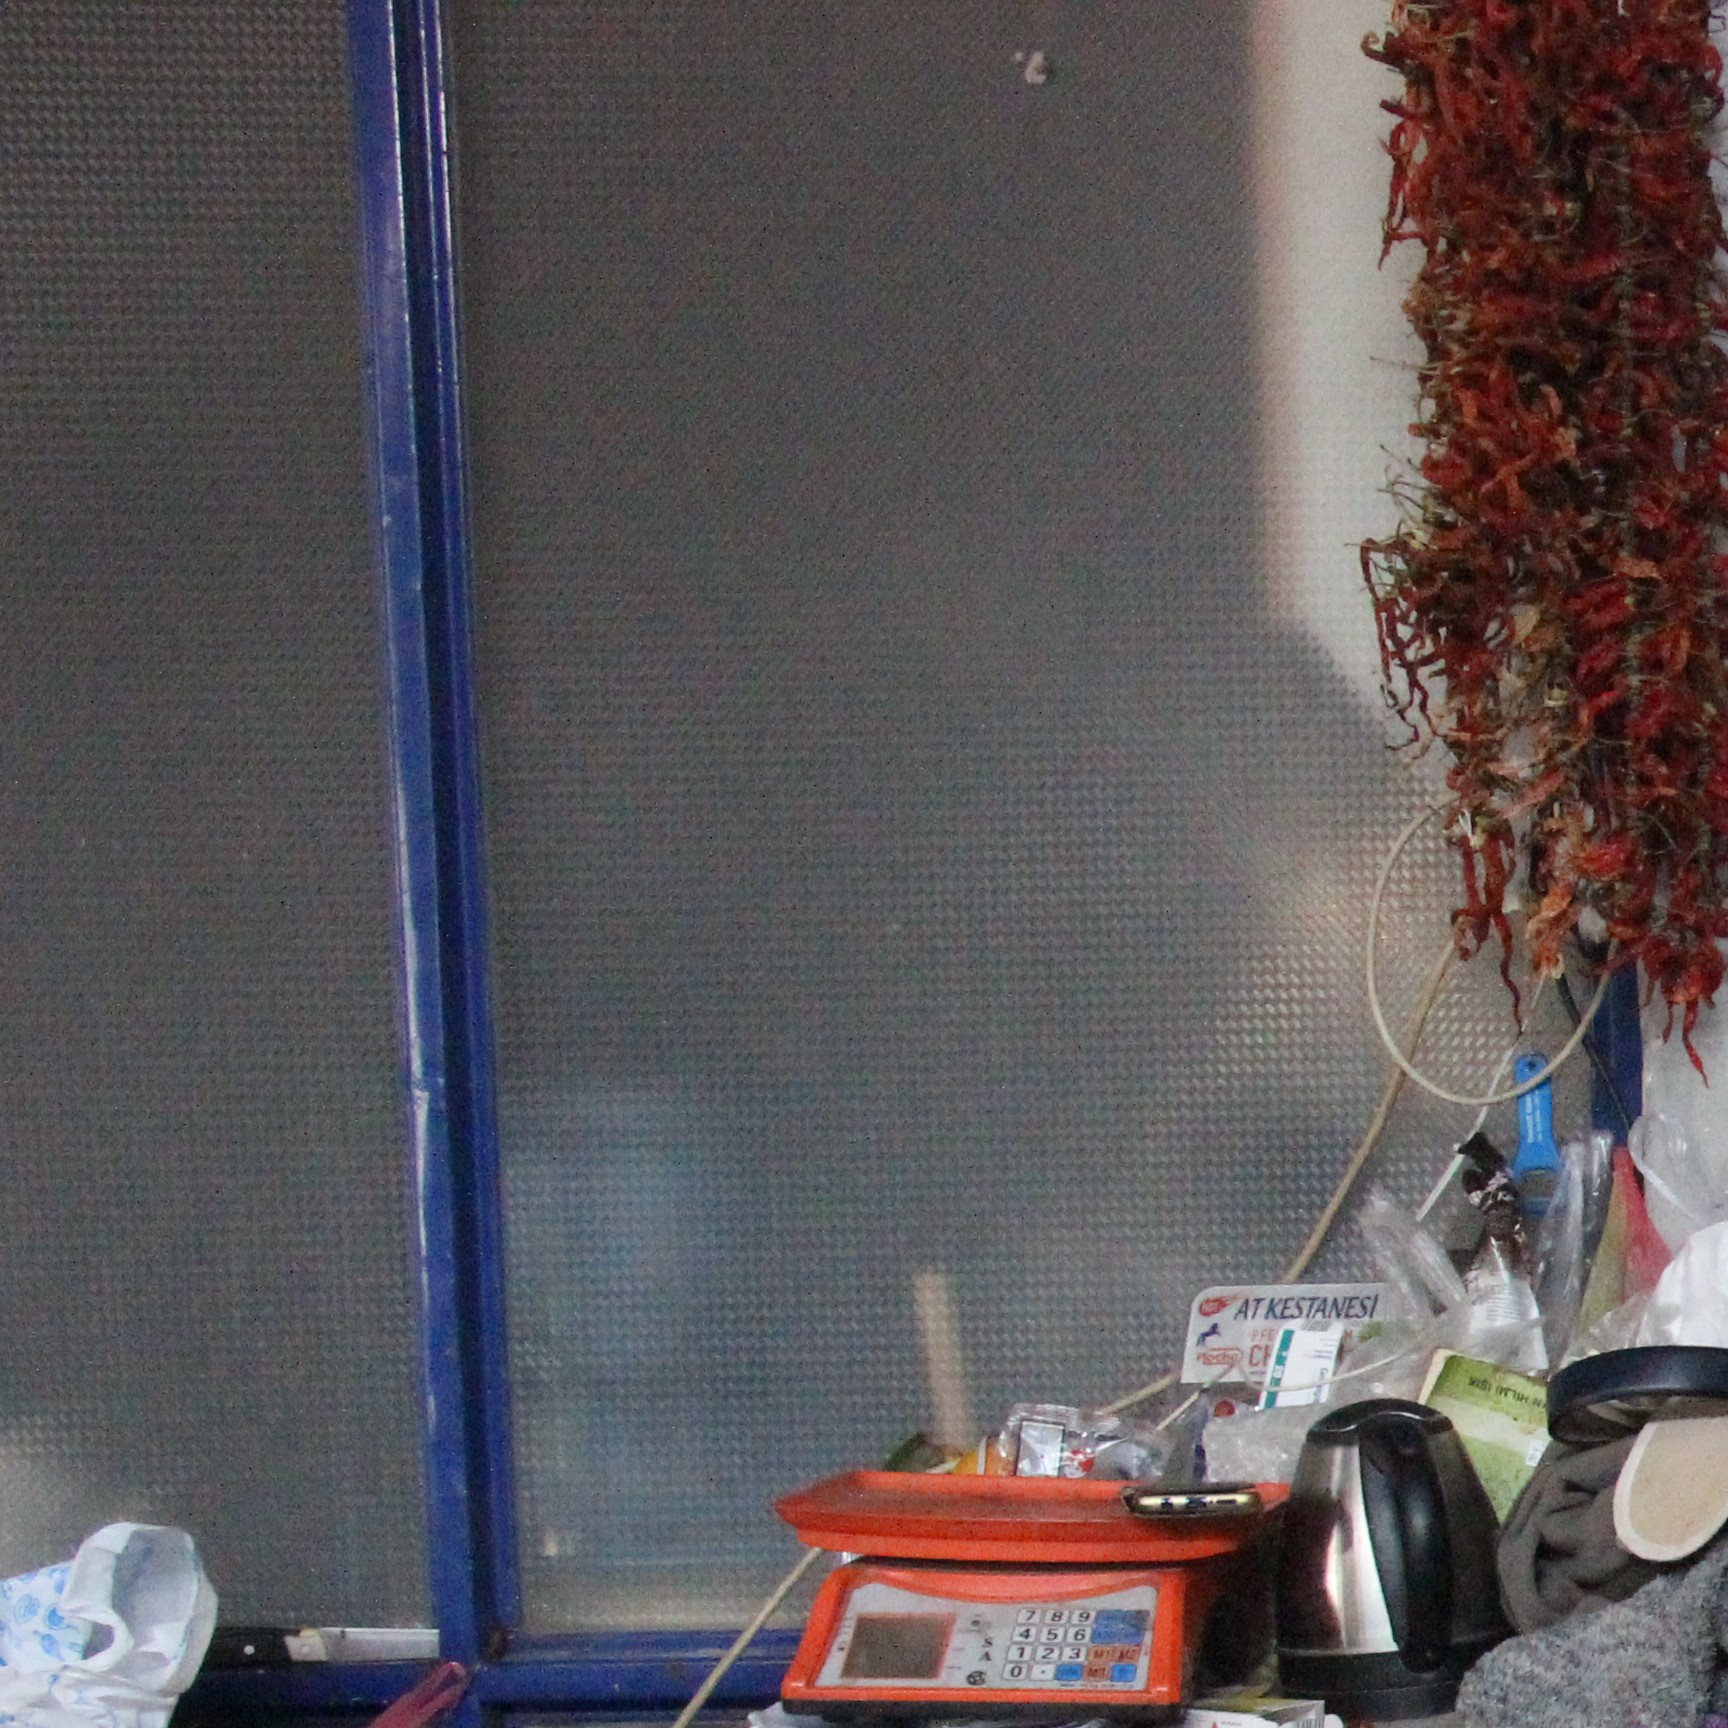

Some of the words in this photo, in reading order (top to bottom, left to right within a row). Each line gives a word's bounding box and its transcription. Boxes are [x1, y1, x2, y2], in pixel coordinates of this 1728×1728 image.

[1232, 1297, 1266, 1320] AT
[1026, 1610, 1036, 1621] 7
[1051, 1611, 1062, 1622] 8
[1078, 1611, 1090, 1622] 9
[1019, 1628, 1031, 1639] 4
[1047, 1629, 1058, 1640] 5
[1074, 1629, 1086, 1640] 6
[1016, 1647, 1025, 1658] 1
[1042, 1648, 1055, 1659] 2
[1069, 1648, 1081, 1659] 3
[1010, 1665, 1022, 1677] 0
